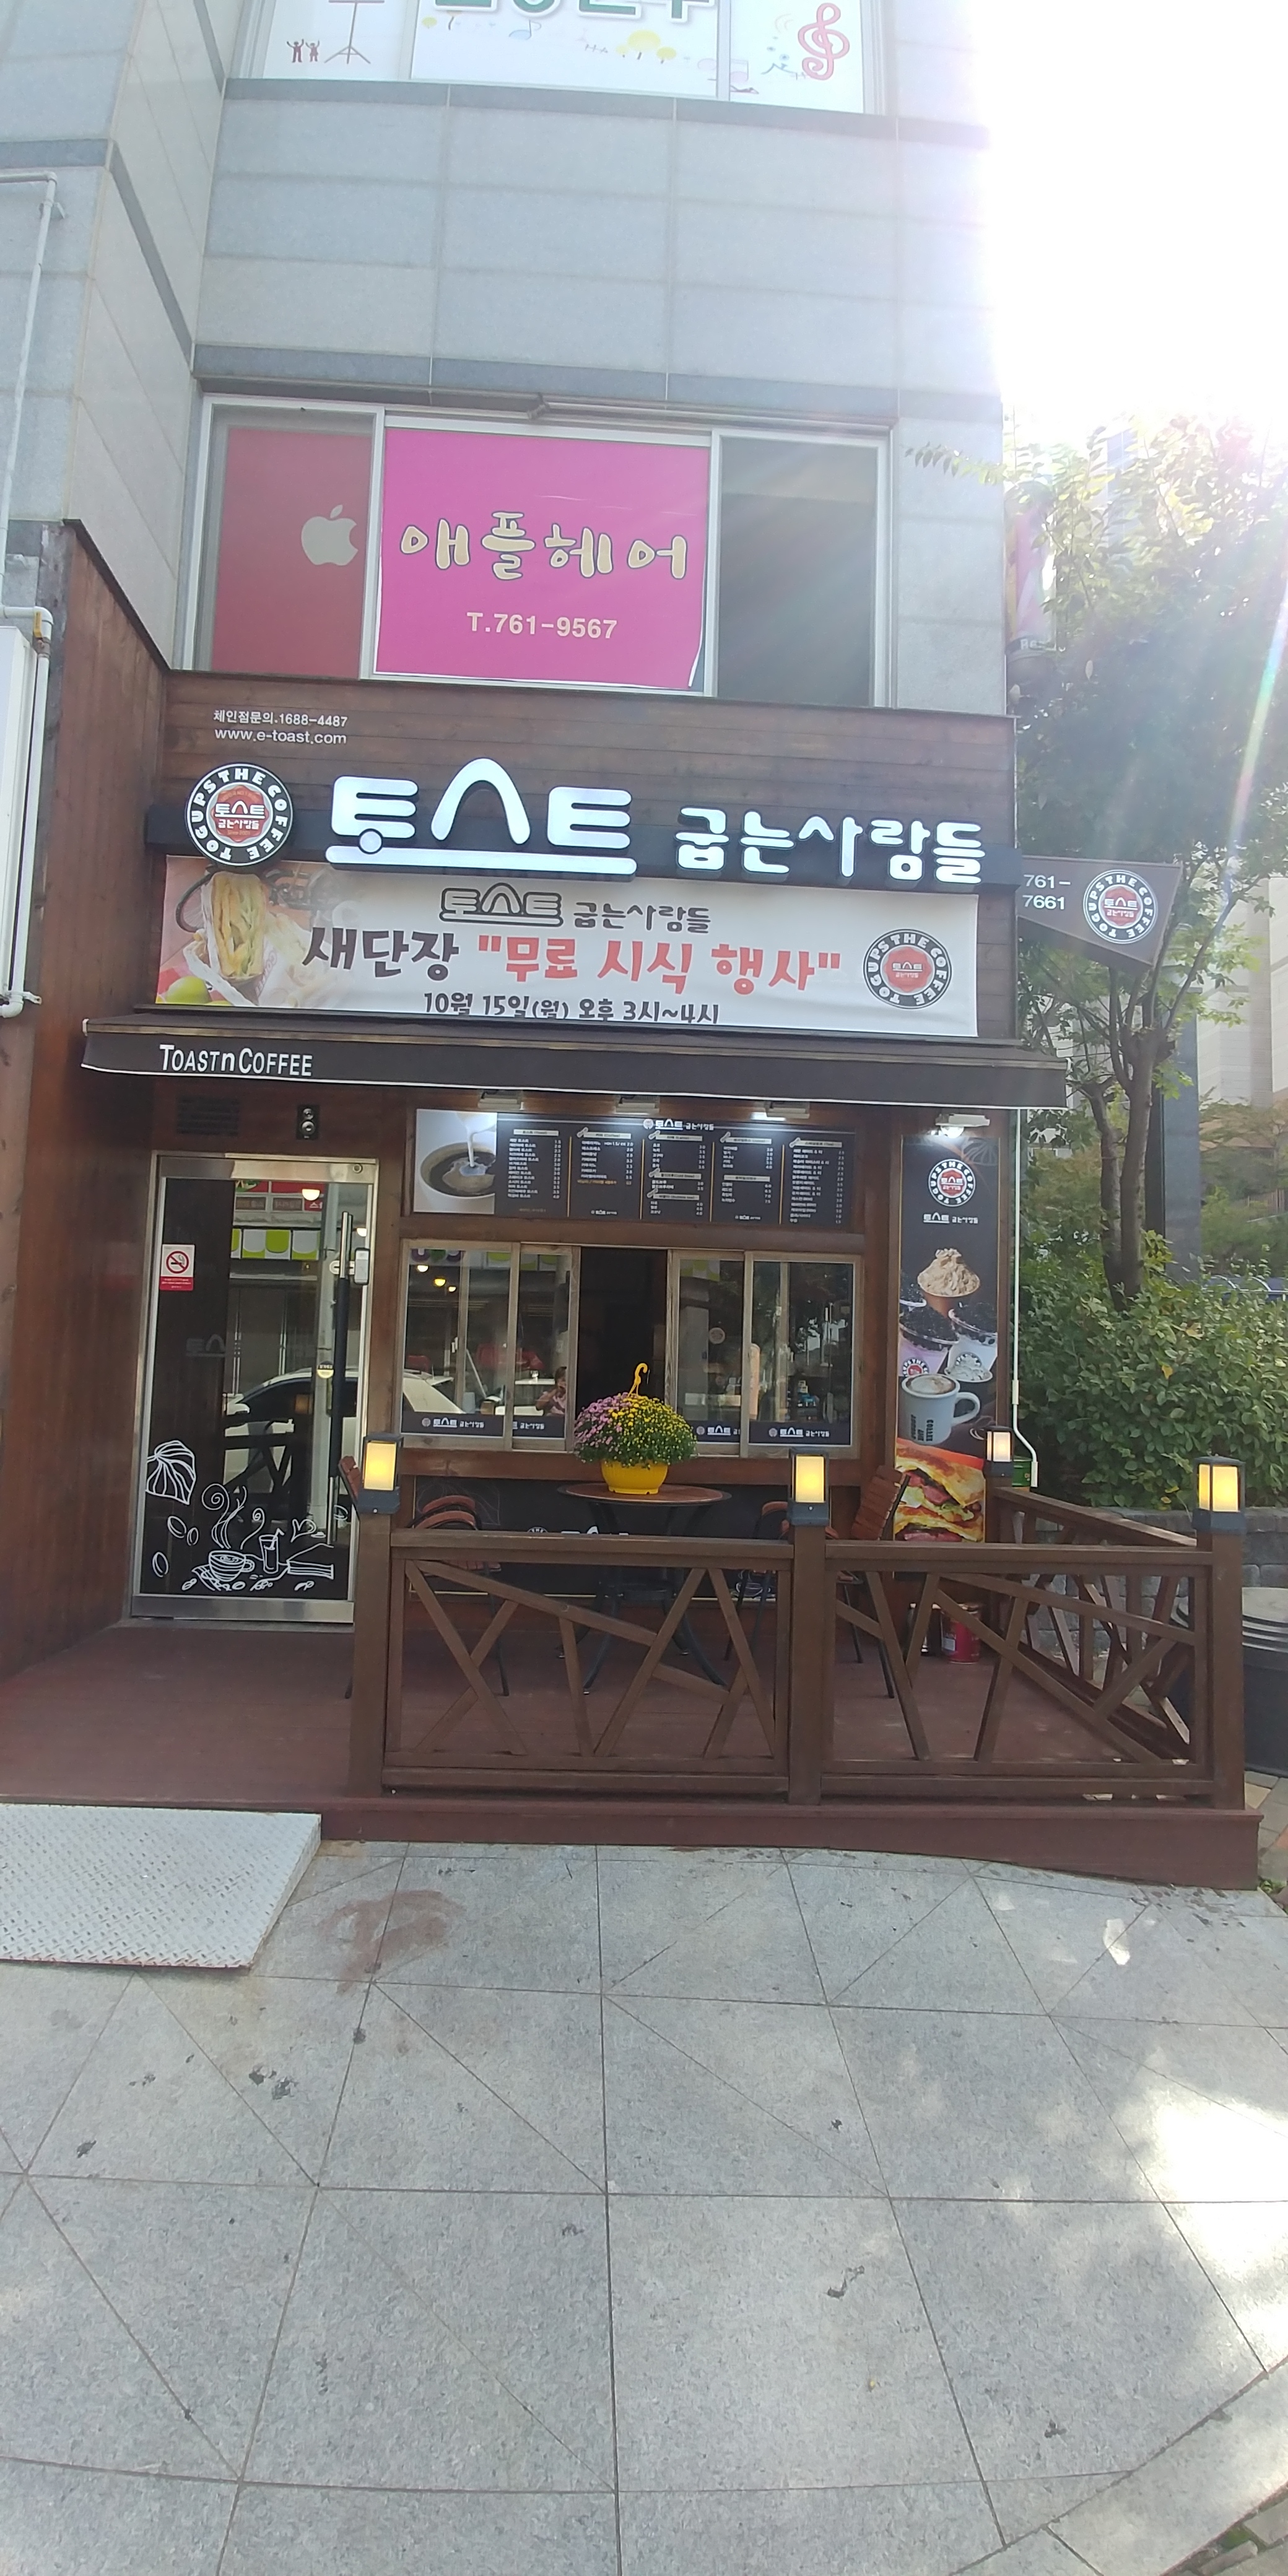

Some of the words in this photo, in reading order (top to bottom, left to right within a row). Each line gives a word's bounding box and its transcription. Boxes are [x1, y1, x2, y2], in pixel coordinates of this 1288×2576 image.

[399, 510, 688, 581] 애플헤어
[466, 611, 618, 641] T.761-9567
[214, 728, 347, 744] www.e-toast.com
[215, 800, 266, 819] 토스트
[217, 768, 266, 785] THE
[246, 785, 288, 860] COFFEE
[324, 757, 638, 876] 토스트
[675, 806, 986, 886] 굽는사람들
[440, 882, 565, 927] 토스트
[573, 902, 710, 934] 굽는사람들
[1022, 895, 1065, 910] 7661
[302, 923, 459, 981] 새단장
[478, 934, 578, 982] "무료
[598, 938, 692, 995] 시식
[710, 941, 842, 995] 행사"
[890, 933, 929, 948] THE
[913, 947, 947, 1005] COFFEE
[424, 992, 474, 1016] 10월
[578, 998, 614, 1021] 오후
